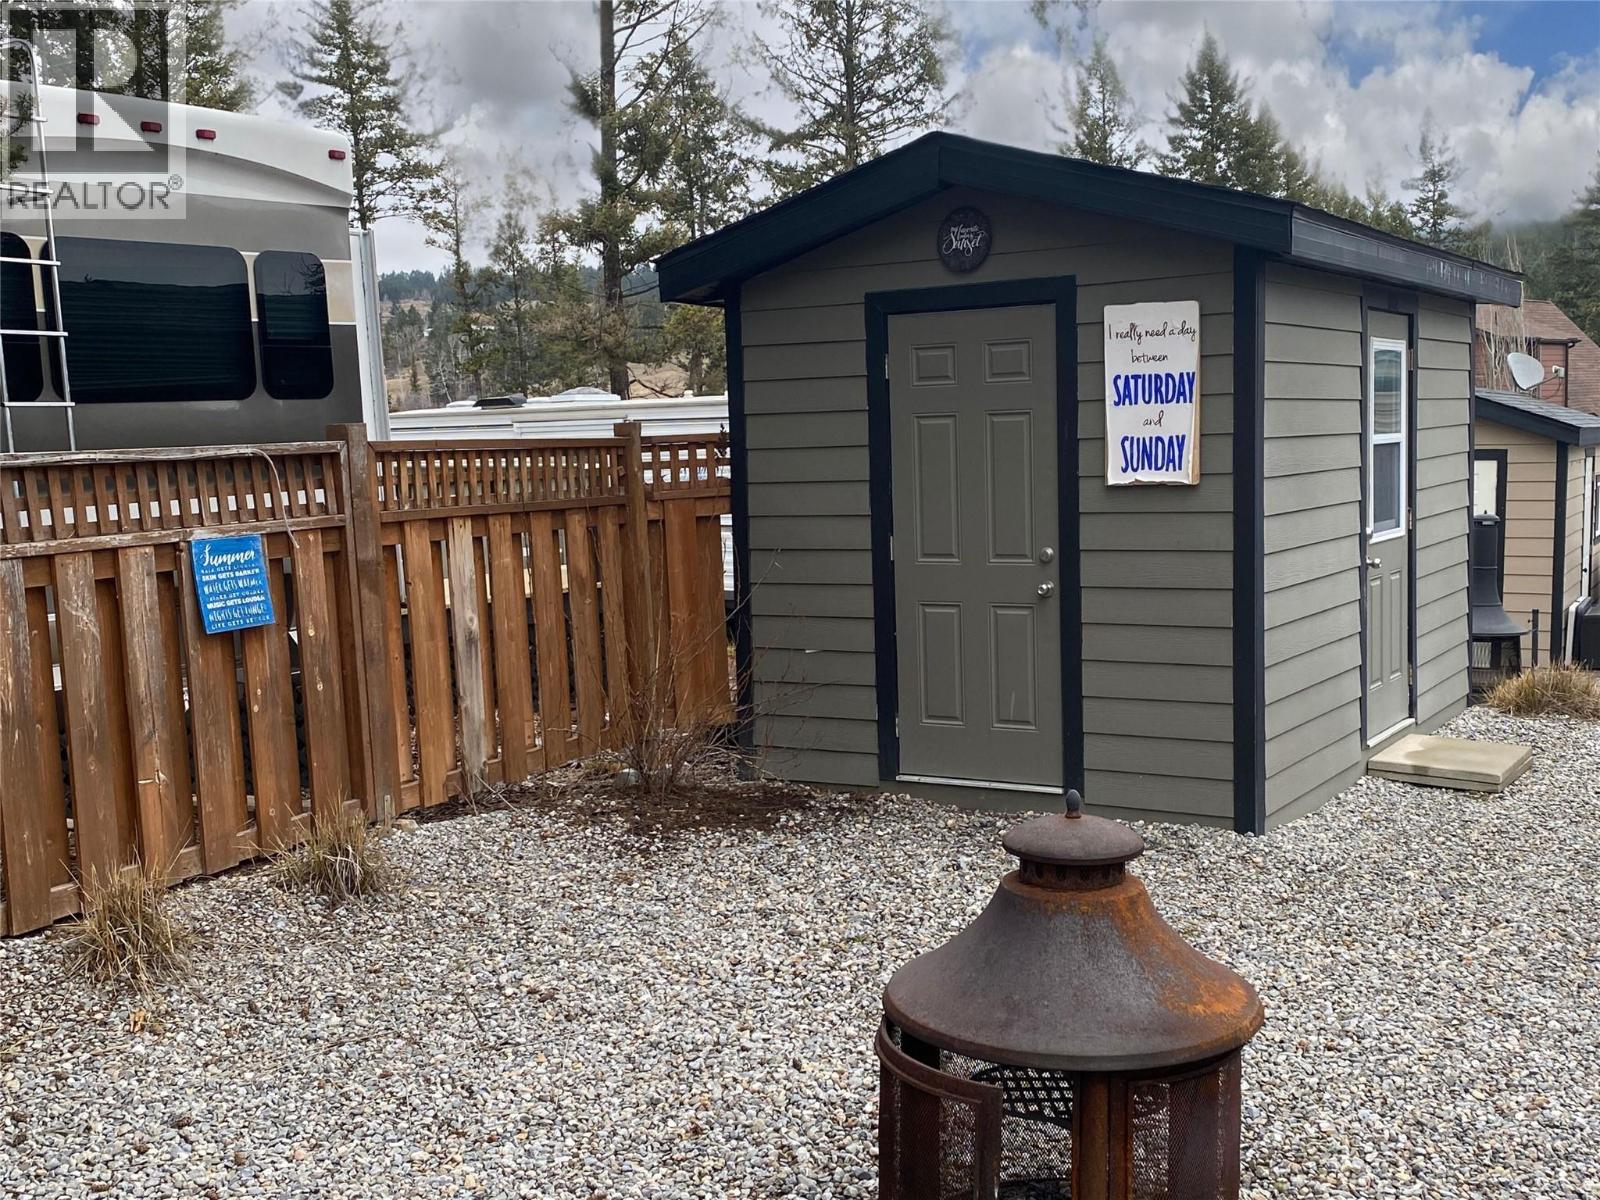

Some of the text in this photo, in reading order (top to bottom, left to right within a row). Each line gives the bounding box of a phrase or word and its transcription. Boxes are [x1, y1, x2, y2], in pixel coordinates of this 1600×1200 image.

[1108, 320, 1196, 345] I really need a day
[1131, 349, 1168, 364] between
[1113, 371, 1196, 406] SATURDAY
[1143, 410, 1164, 427] and
[1120, 434, 1186, 473] SUNDAY
[200, 543, 255, 567] Summer
[202, 573, 217, 581] SKIN
[217, 571, 234, 579] GETS
[226, 598, 242, 606] GETS
